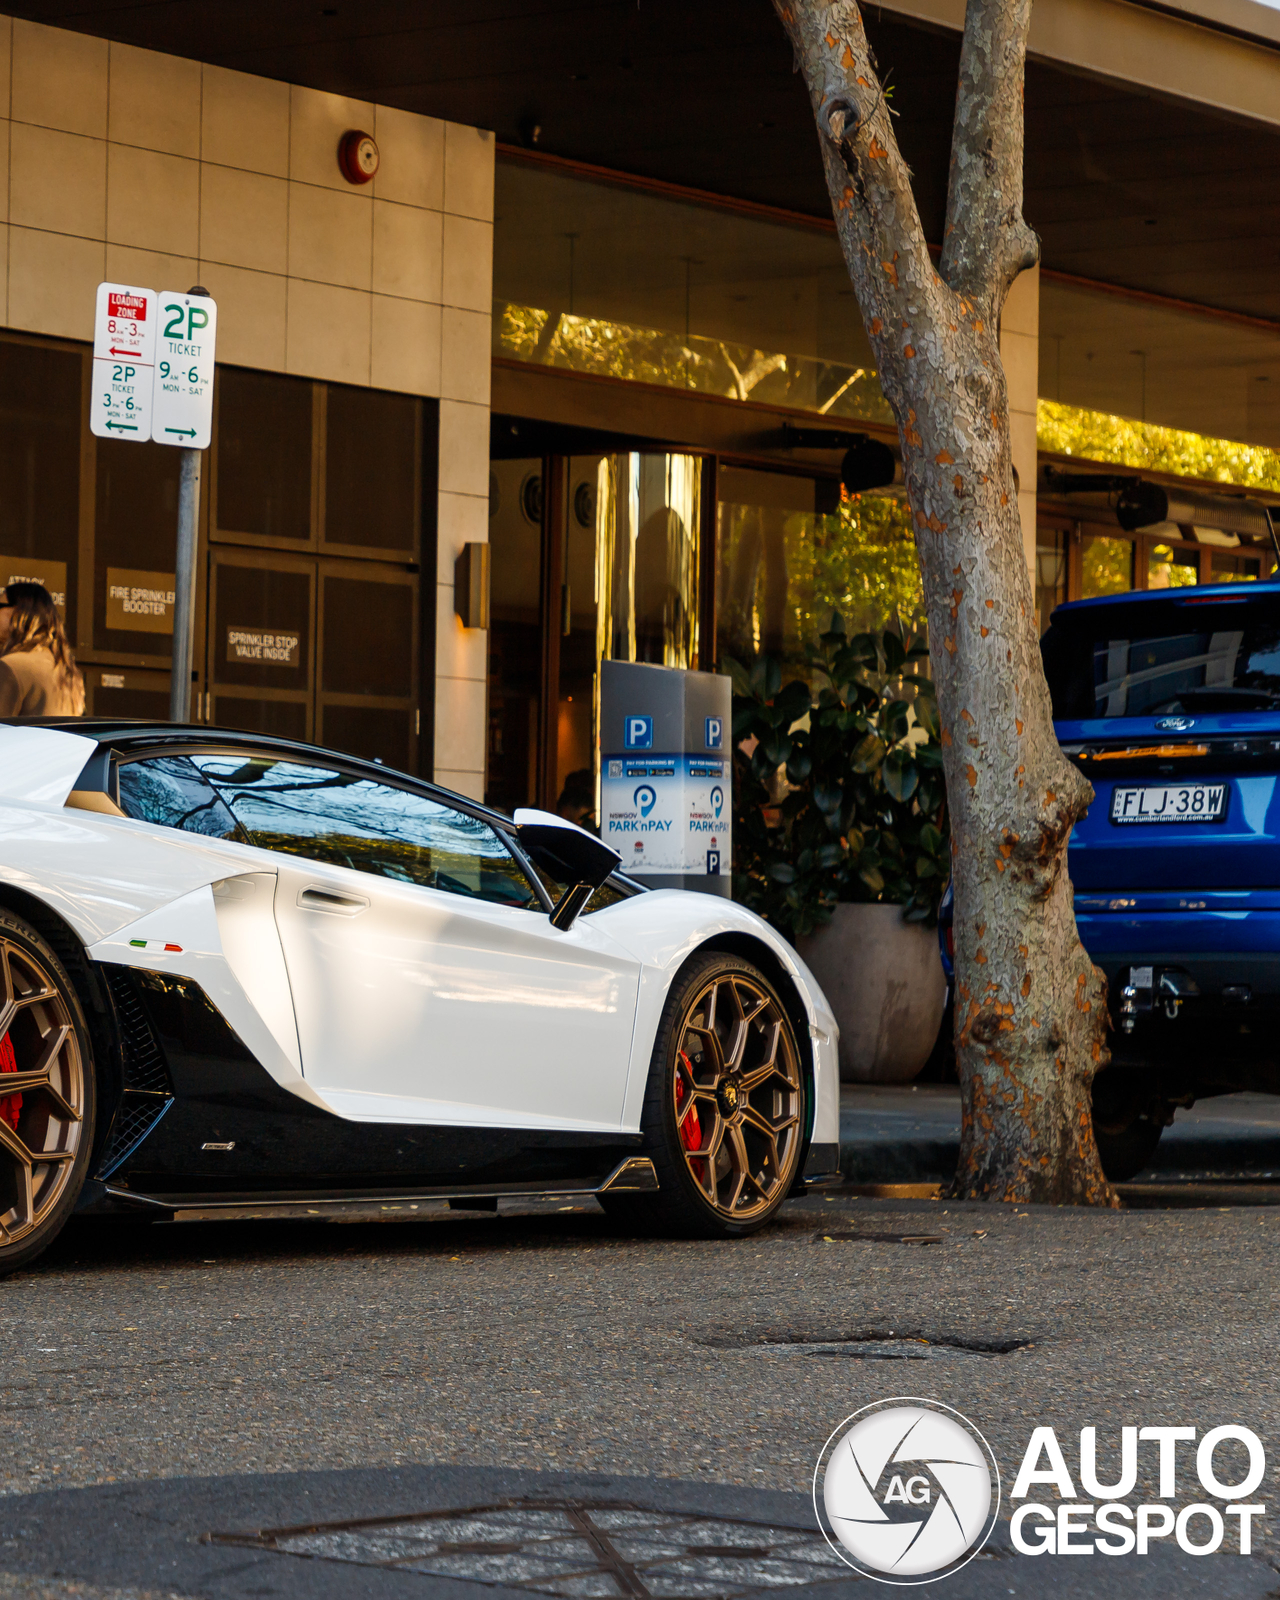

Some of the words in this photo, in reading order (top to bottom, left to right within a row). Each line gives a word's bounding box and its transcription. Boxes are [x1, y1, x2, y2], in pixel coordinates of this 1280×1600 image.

[111, 293, 144, 309] LOADING
[116, 306, 137, 319] ZONE
[163, 304, 209, 341] 2P
[111, 336, 124, 344] MON
[129, 338, 140, 346] SAT
[168, 341, 202, 357] TICKET
[112, 365, 136, 382] 2P
[111, 383, 135, 394] TICKET
[162, 383, 180, 393] MON
[188, 386, 204, 396] SAT
[107, 410, 121, 418] MON
[125, 412, 136, 420] SAT
[110, 585, 130, 600] FIRE
[122, 599, 166, 615] BOOSTER
[228, 631, 275, 648] SPRINKLER
[275, 635, 298, 650] STOP
[235, 645, 262, 659] VALVE
[263, 647, 291, 661] INSIDE
[630, 719, 647, 745] P
[709, 720, 720, 746] P
[1117, 813, 1213, 823] www.cumberlandford.com.au
[709, 853, 718, 872] P
